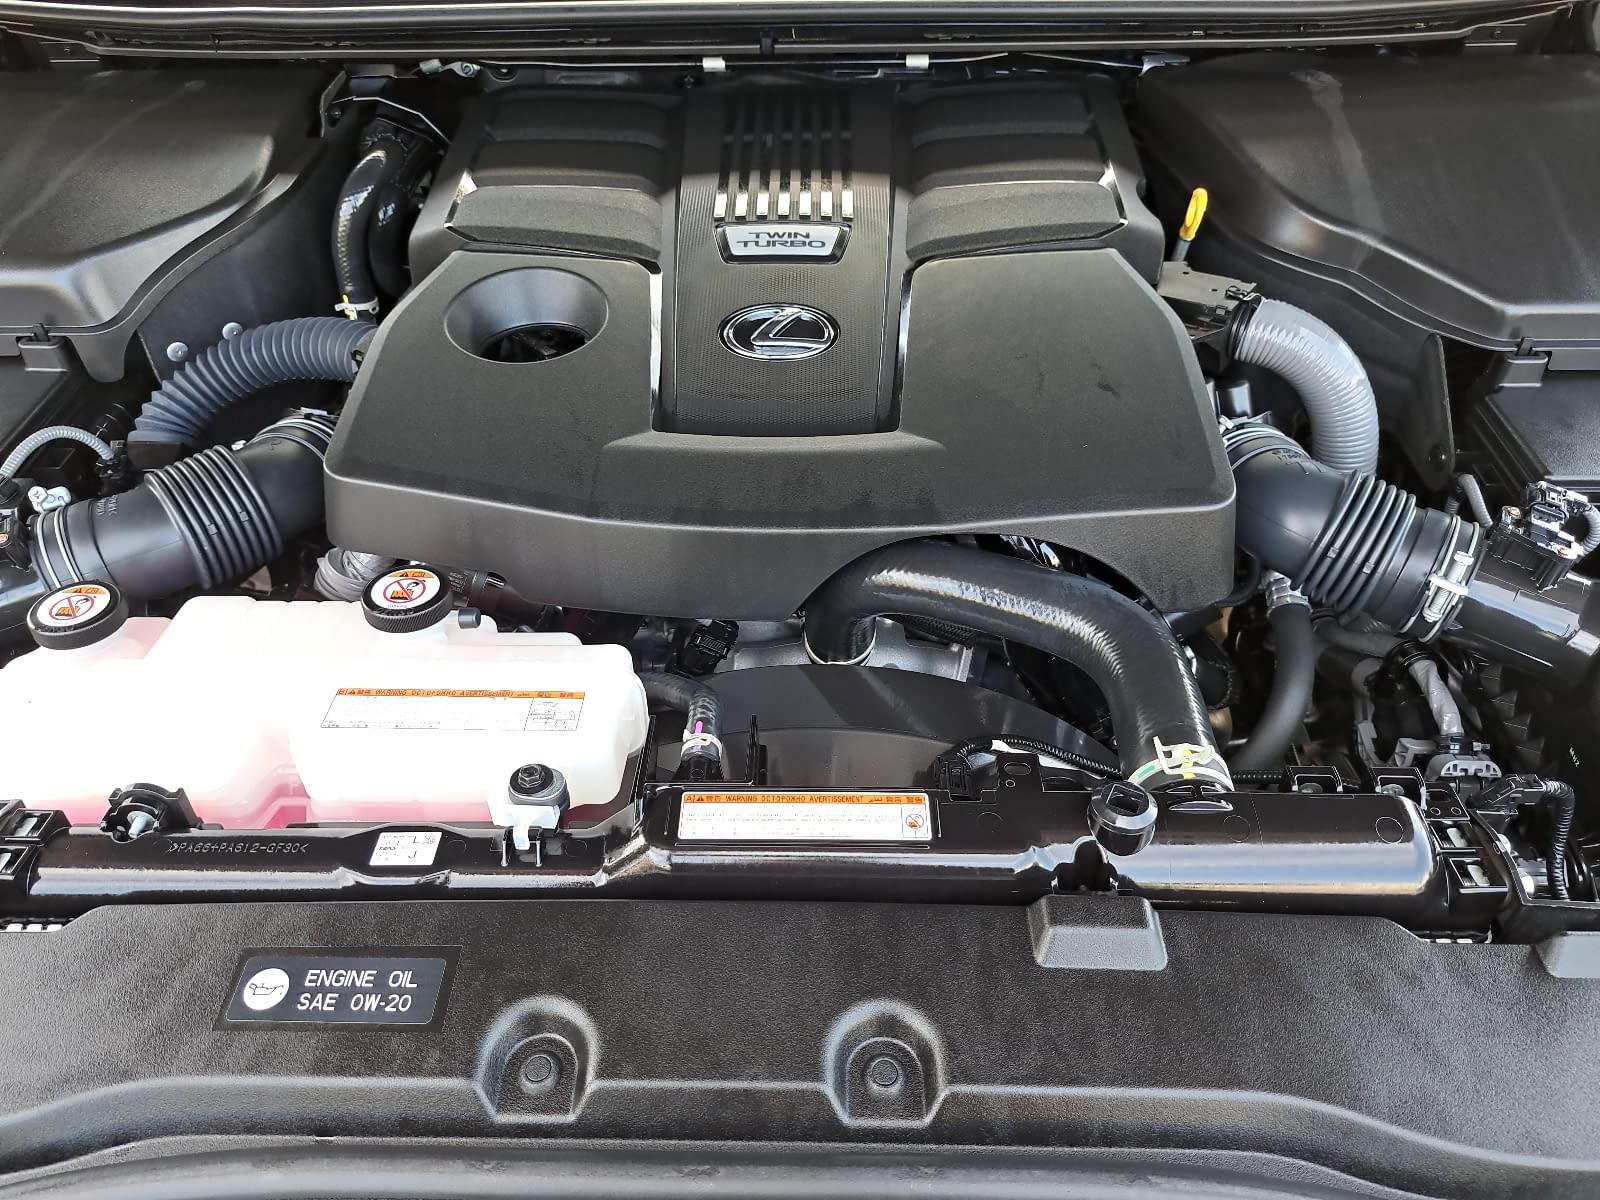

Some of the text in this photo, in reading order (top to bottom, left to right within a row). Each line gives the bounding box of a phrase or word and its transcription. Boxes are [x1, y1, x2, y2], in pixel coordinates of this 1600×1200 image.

[748, 231, 810, 239] TWIN
[736, 240, 826, 248] TURBO
[809, 795, 864, 803] AVERTISSEMENT
[304, 969, 418, 988] ENGINE OIL
[297, 993, 412, 1012] SAE 0W-20
